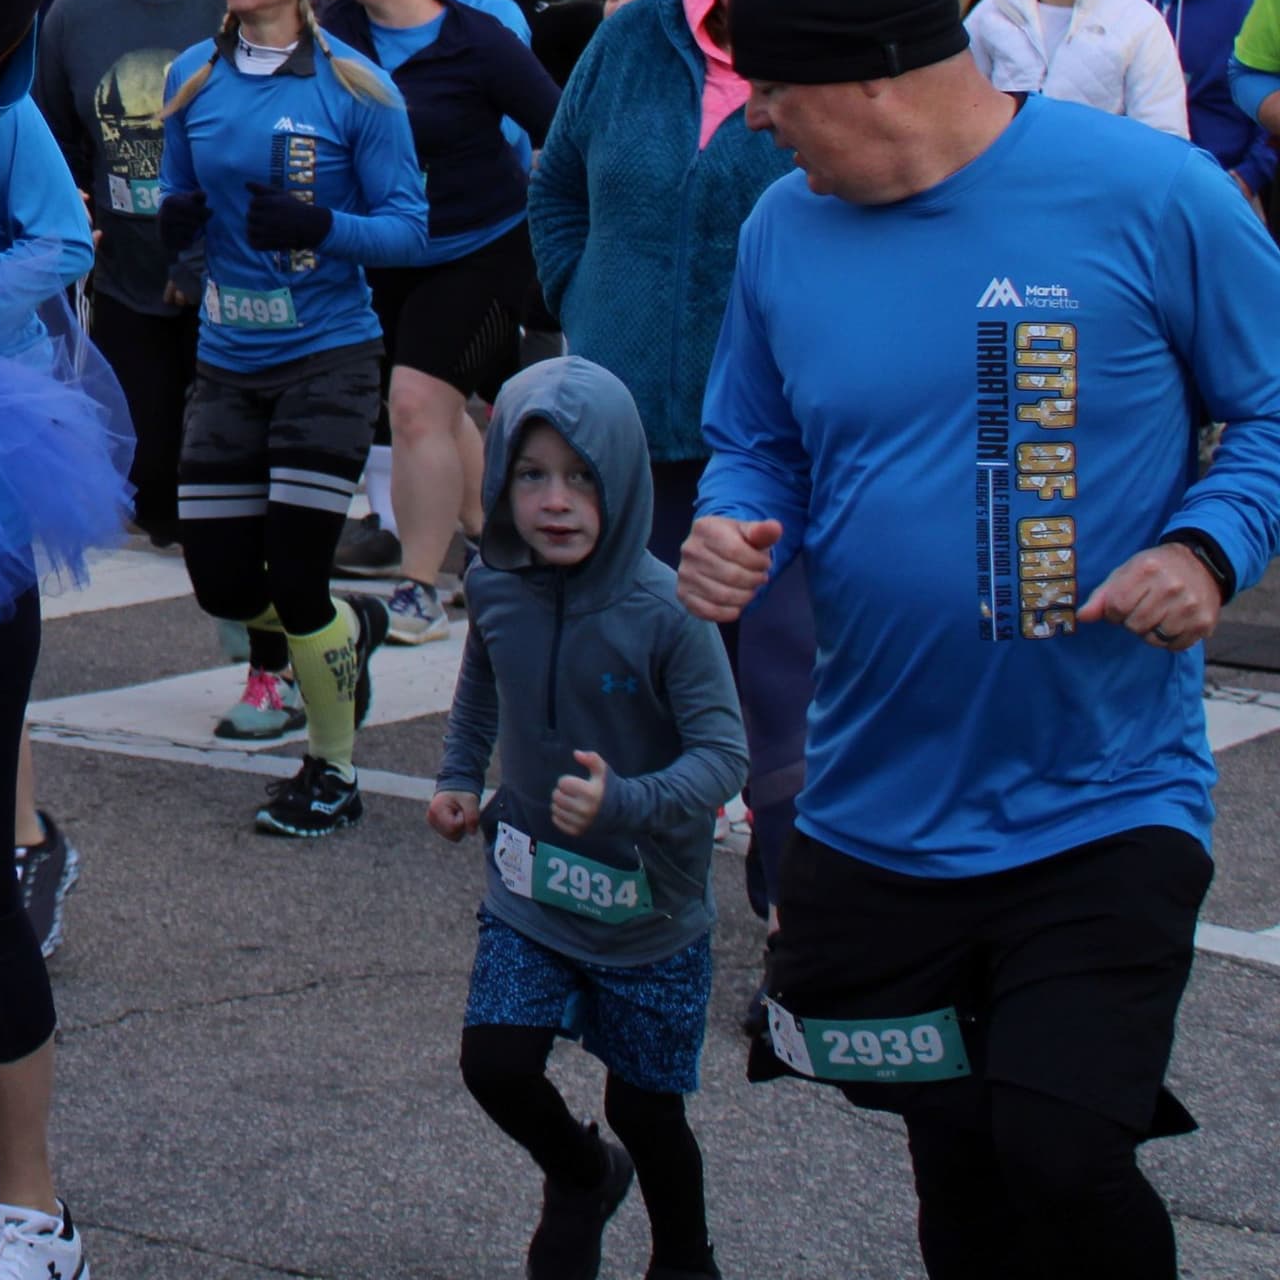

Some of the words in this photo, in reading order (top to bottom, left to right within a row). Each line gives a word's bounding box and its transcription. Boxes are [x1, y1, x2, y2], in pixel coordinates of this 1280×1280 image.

[223, 294, 289, 323] 5499
[1024, 297, 1079, 309] Marietta
[1025, 284, 1068, 297] Martin
[976, 321, 1009, 460] MARATHON
[1014, 322, 1078, 429] CITY
[1015, 441, 1078, 501] OF
[1015, 515, 1078, 640] OAKS
[547, 857, 638, 908] 2934
[822, 1025, 944, 1066] 2939
